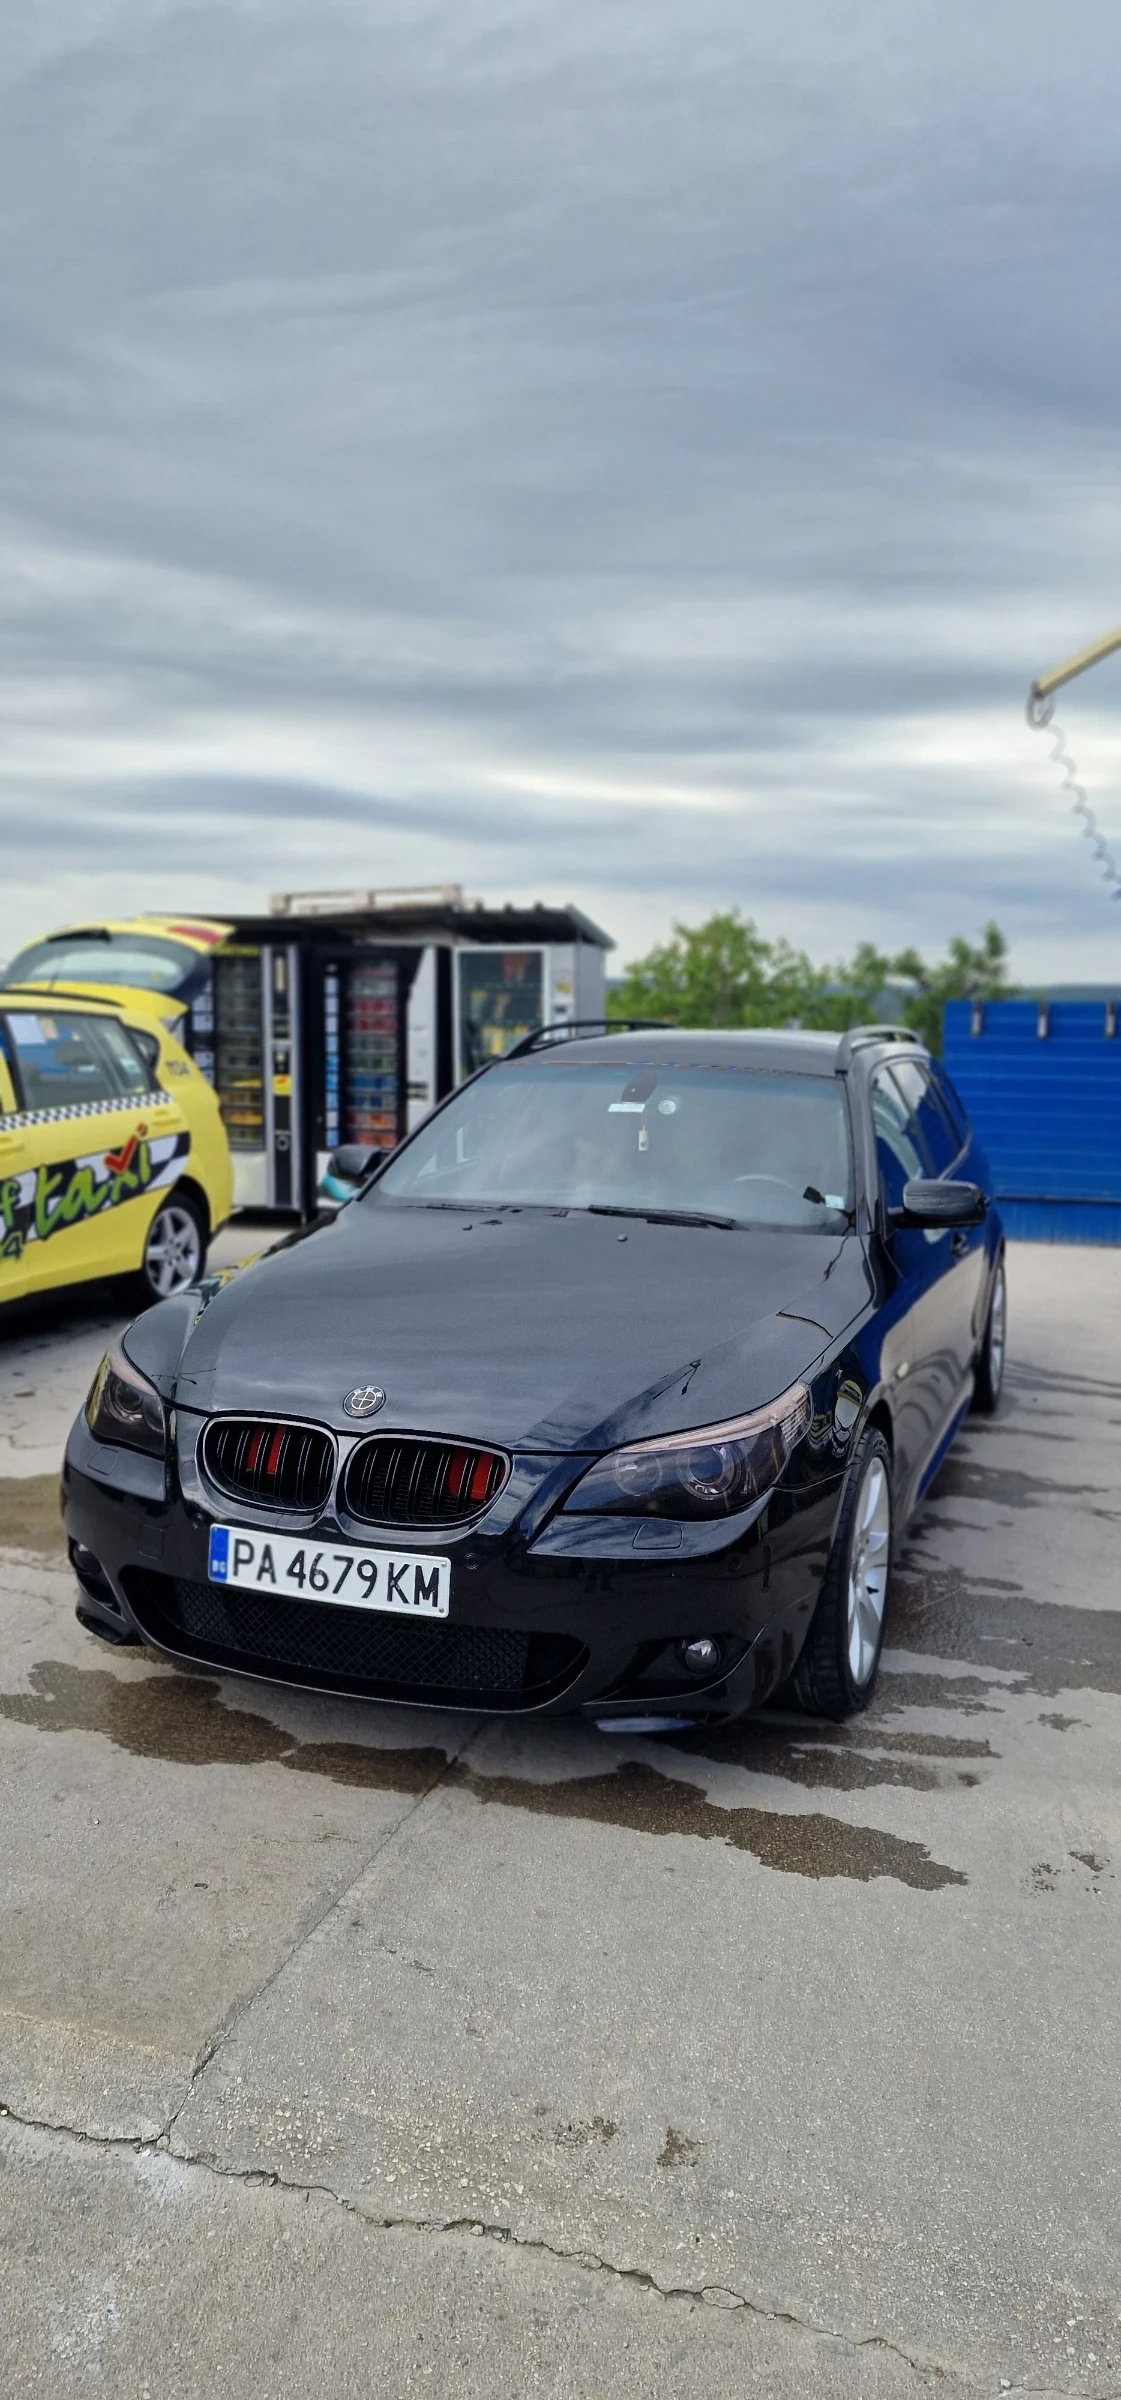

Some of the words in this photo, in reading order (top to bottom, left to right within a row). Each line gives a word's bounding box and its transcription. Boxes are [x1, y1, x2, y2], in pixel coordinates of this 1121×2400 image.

[36, 1122, 150, 1239] taxi
[212, 1559, 227, 1573] BG
[232, 1538, 277, 1584] PA
[286, 1549, 378, 1599] 4679
[386, 1561, 440, 1608] KM
